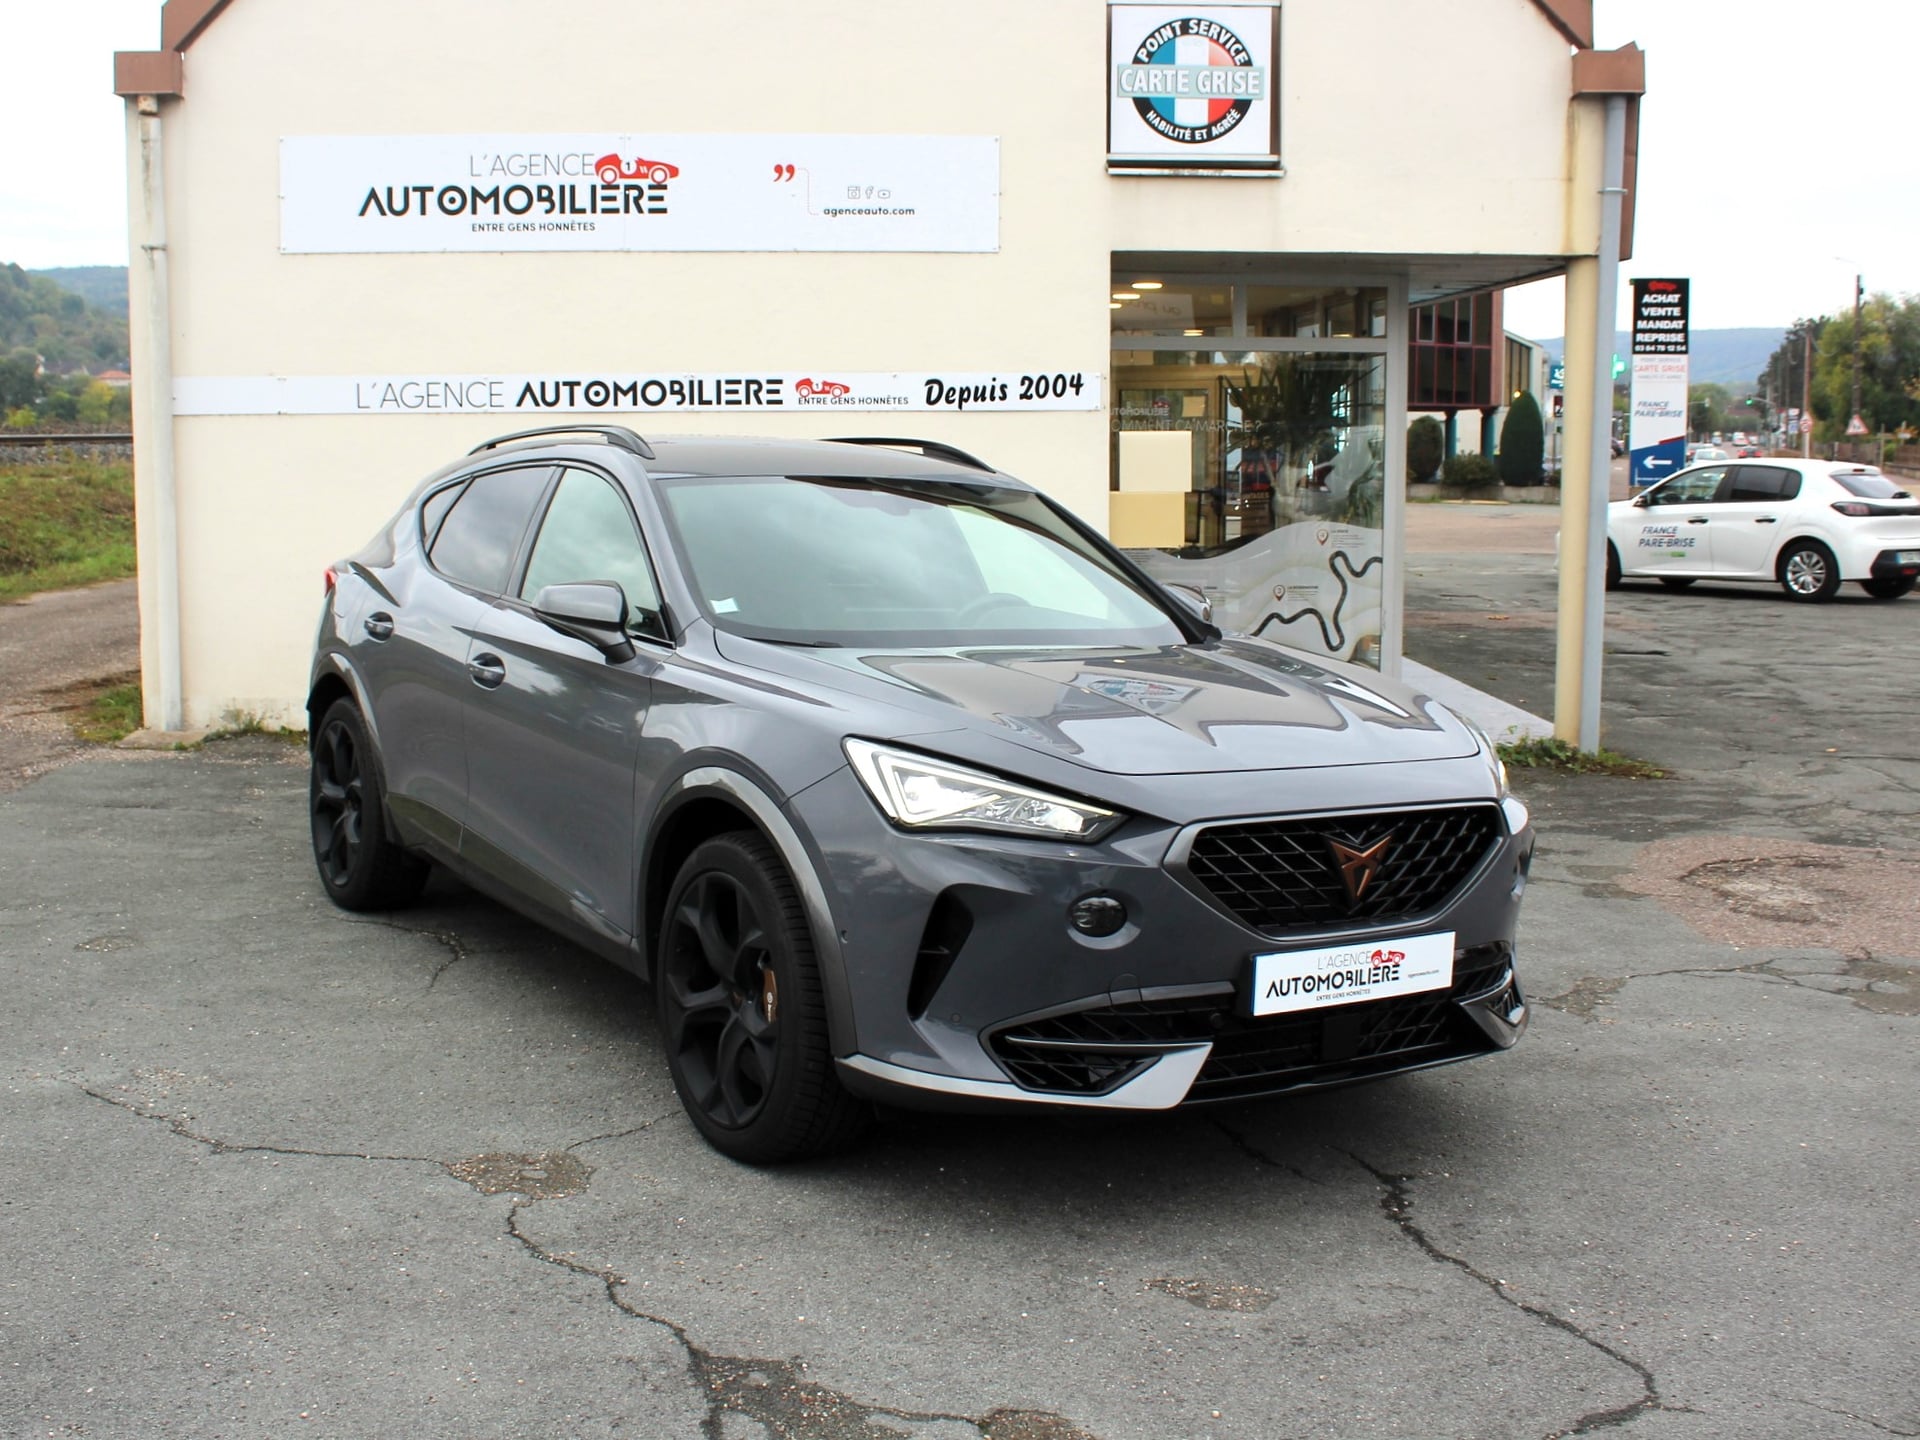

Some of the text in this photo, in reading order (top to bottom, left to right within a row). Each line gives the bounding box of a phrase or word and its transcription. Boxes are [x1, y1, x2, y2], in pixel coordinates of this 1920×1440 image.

[1137, 19, 1248, 66] POINT SERVICE
[1120, 69, 1260, 95] CARTE GRISE
[1146, 108, 1241, 141] HABILITÉ ET AGRÉÉ
[470, 153, 595, 177] L'AGENCE
[823, 206, 916, 217] agenceauto.com
[472, 220, 595, 232] ENTRE GENS HONNÊTES
[1642, 294, 1681, 303] ACHAT
[1641, 307, 1681, 316] VENTE
[1637, 320, 1685, 329] MANDAT
[1636, 333, 1685, 342] REPRISE
[356, 382, 504, 409] L'AGENCE
[924, 373, 1085, 410] Depuis 2004
[798, 395, 909, 405] ENTRE GENS HONNÊTES
[1642, 526, 1678, 534] FRANCE
[1638, 538, 1695, 547] PARE-BRISE
[1317, 950, 1372, 970] L'AGENCE
